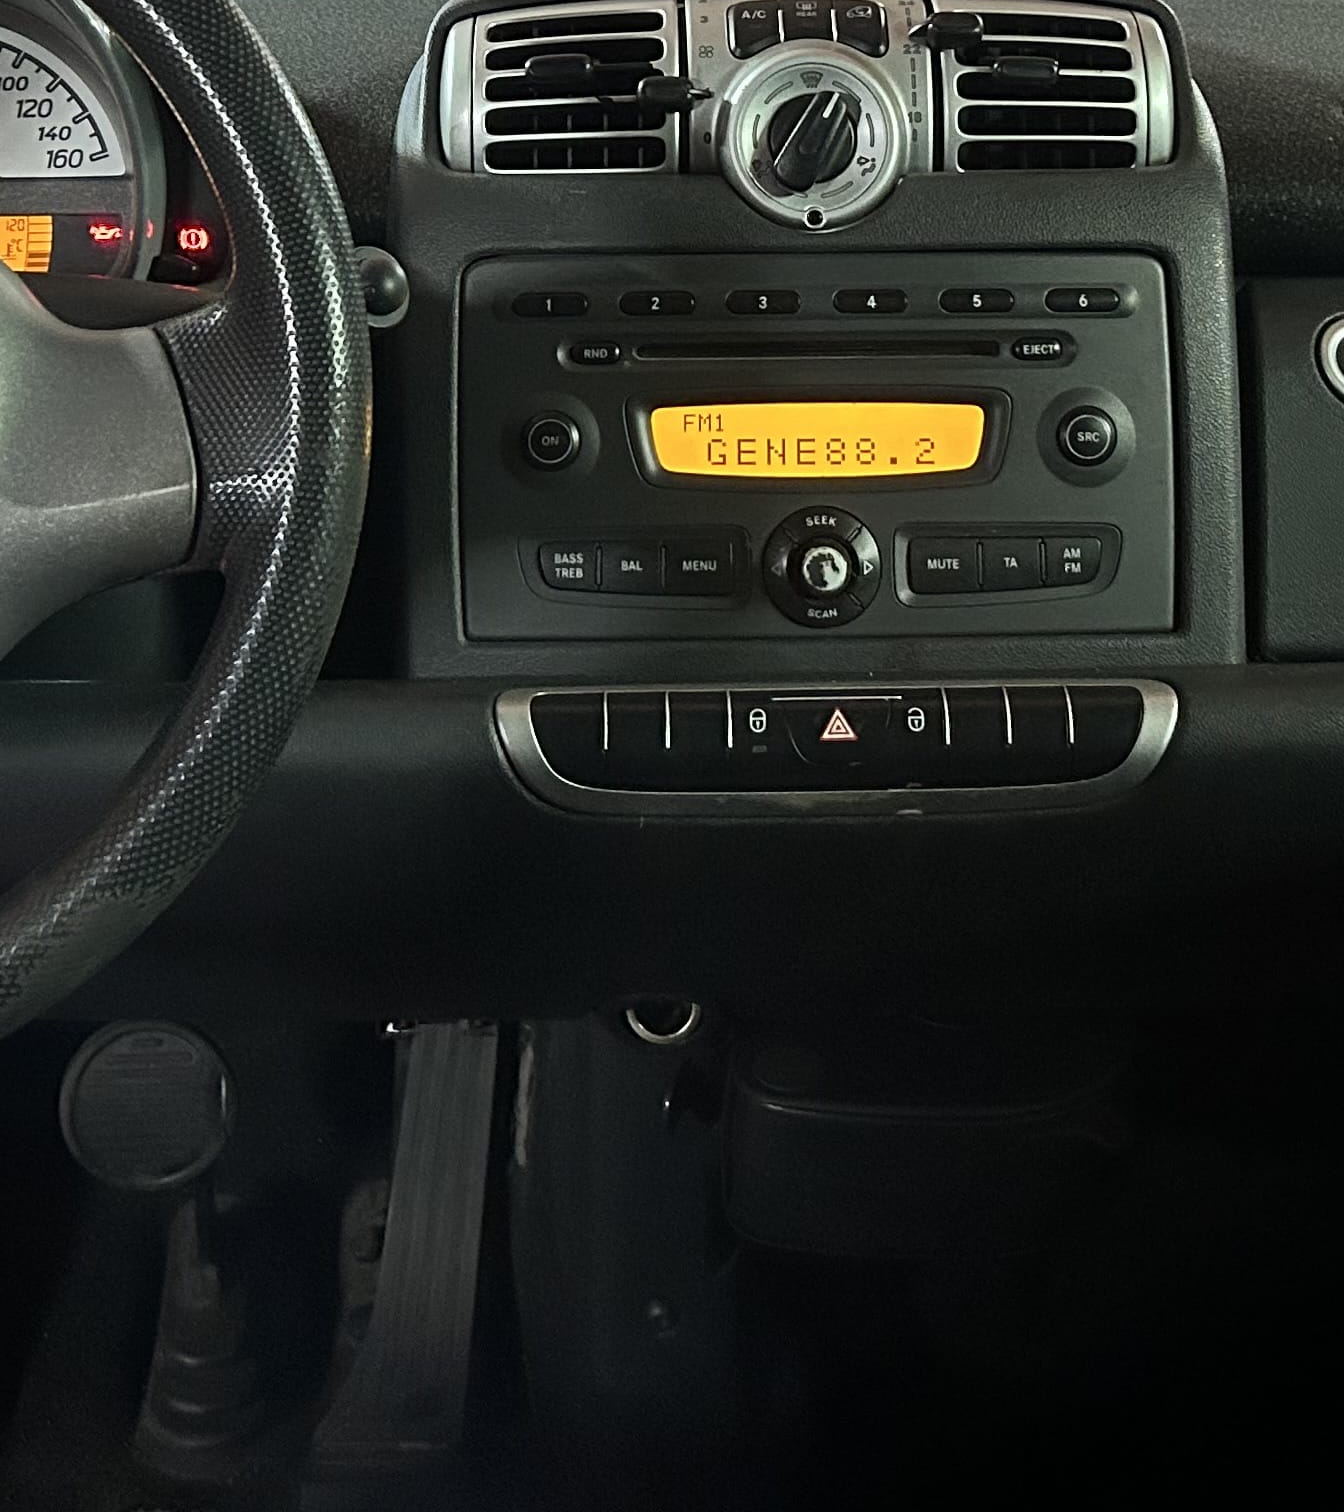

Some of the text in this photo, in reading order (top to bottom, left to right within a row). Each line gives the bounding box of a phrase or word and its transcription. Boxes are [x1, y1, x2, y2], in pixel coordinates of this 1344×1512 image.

[741, 9, 767, 20] A/C
[902, 43, 922, 55] 22
[16, 98, 53, 119] 120
[38, 125, 72, 141] 140
[46, 148, 84, 169] 160
[5, 218, 25, 232] 120
[545, 298, 552, 312] 1
[651, 296, 660, 311] 2
[758, 295, 768, 310] 3
[866, 294, 877, 309] 4
[972, 293, 983, 308] 5
[1078, 292, 1088, 307] 6
[583, 348, 608, 359] RND
[1022, 343, 1055, 355] EJECT
[683, 414, 724, 433] FM1
[541, 435, 560, 447] ON
[1077, 430, 1100, 443] SRC
[707, 438, 935, 465] GENE88.2
[805, 514, 837, 527] SEEK
[554, 553, 584, 564] BASS
[1063, 548, 1081, 558] AM
[620, 560, 643, 572] BAL
[682, 559, 717, 572] MENU
[927, 558, 960, 570] MUTE
[1004, 556, 1018, 568] TA
[1064, 562, 1081, 573] FM
[555, 567, 584, 578] TREB
[807, 608, 838, 620] SCAN
